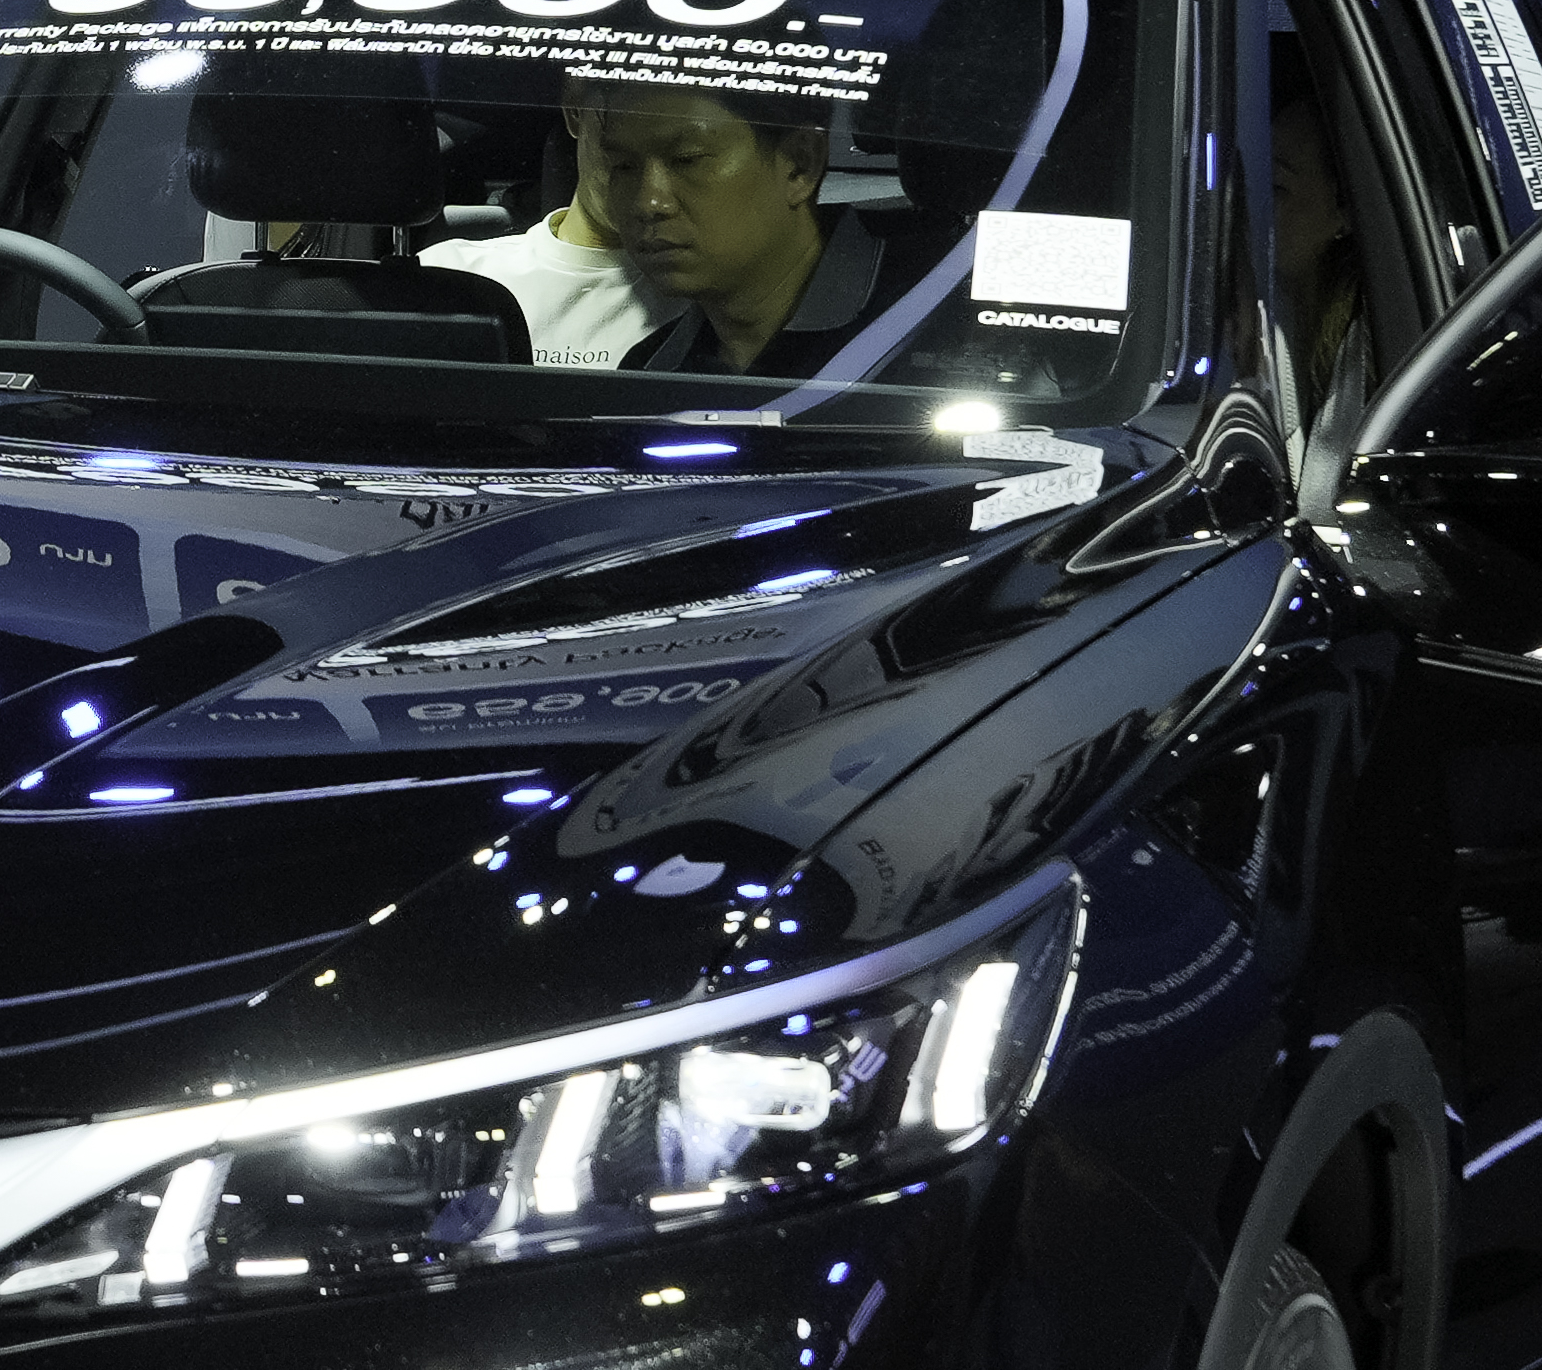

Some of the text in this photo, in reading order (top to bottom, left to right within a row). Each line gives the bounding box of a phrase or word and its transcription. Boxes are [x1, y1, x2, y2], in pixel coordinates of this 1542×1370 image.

[67, 19, 173, 38] Package
[732, 38, 830, 59] 50,000
[834, 47, 888, 66] บาท
[108, 40, 119, 52] 1
[254, 38, 266, 51] 1
[495, 43, 548, 58] XUV
[547, 47, 606, 62] MAX
[629, 52, 679, 67] Film
[977, 309, 1121, 335] CATALOGUE
